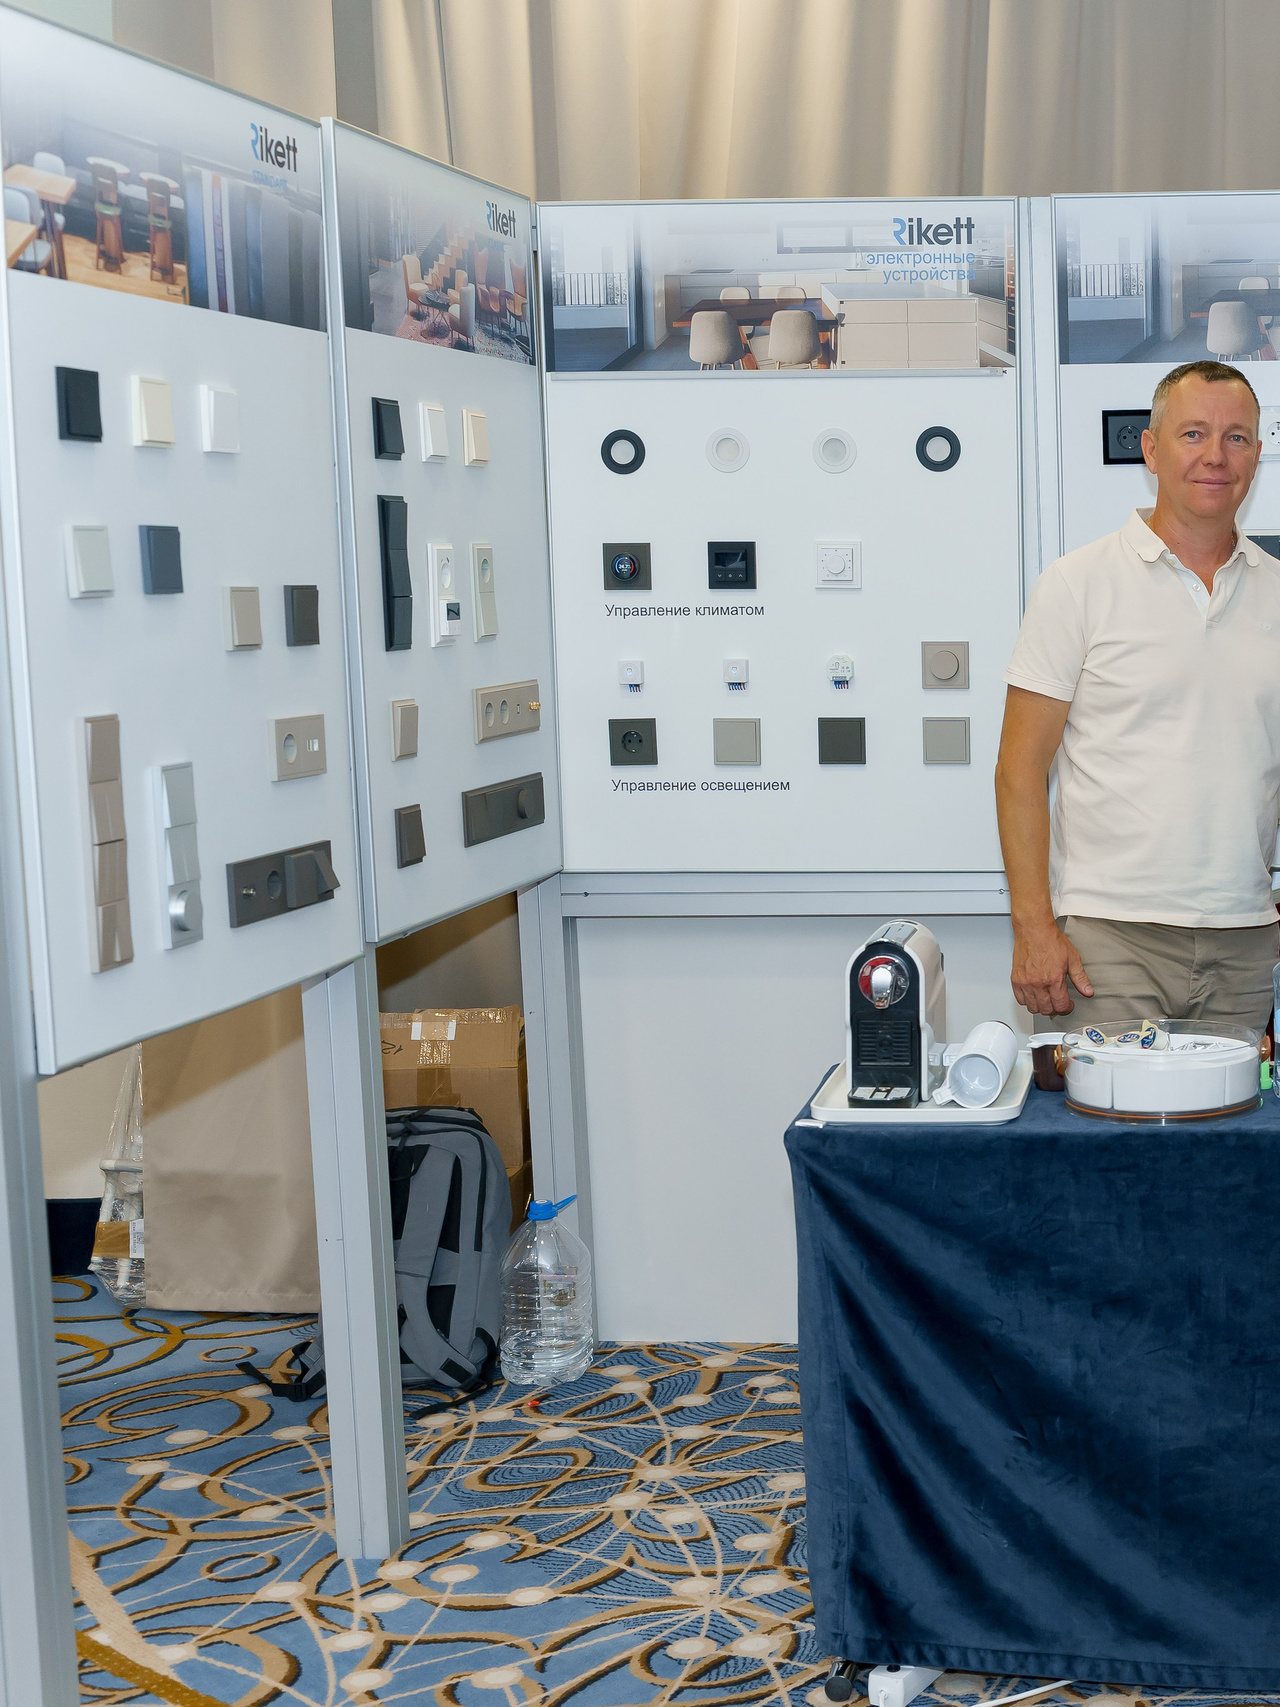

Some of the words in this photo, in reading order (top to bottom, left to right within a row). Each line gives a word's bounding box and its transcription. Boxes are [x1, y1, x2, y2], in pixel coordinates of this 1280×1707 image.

[250, 123, 298, 172] Rikett
[486, 200, 516, 238] Rikett
[892, 217, 975, 245] Rikett
[866, 252, 976, 267] электронные
[883, 267, 976, 284] устройства
[605, 604, 692, 619] Управление
[695, 605, 765, 616] климатом
[611, 779, 697, 793] Управление
[701, 779, 790, 792] освещением
